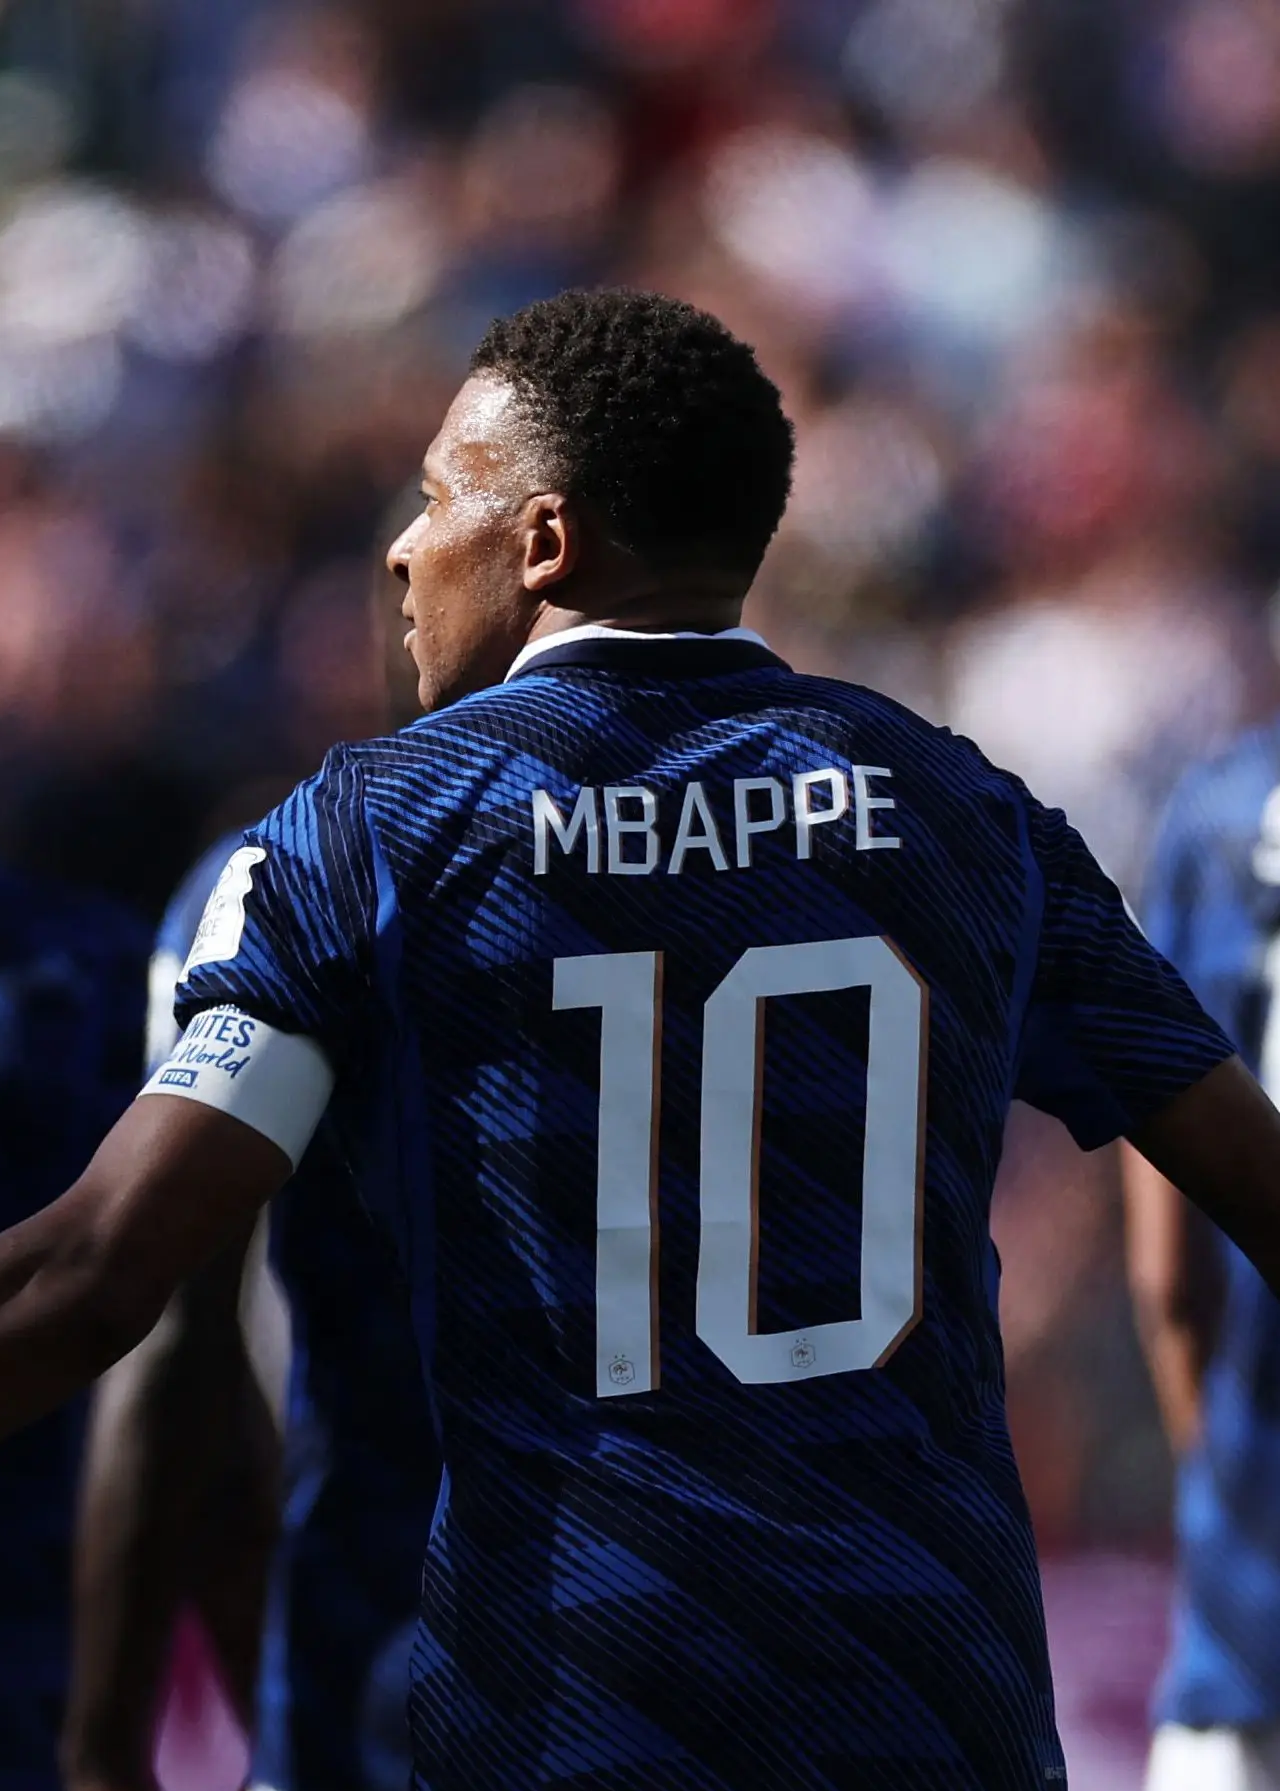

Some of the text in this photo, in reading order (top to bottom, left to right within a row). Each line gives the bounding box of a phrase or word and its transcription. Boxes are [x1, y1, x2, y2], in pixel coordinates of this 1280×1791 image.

[532, 765, 903, 875] MBAPPE
[183, 1014, 256, 1048] NITES
[160, 1070, 195, 1086] FIFA
[552, 935, 930, 1398] 10
